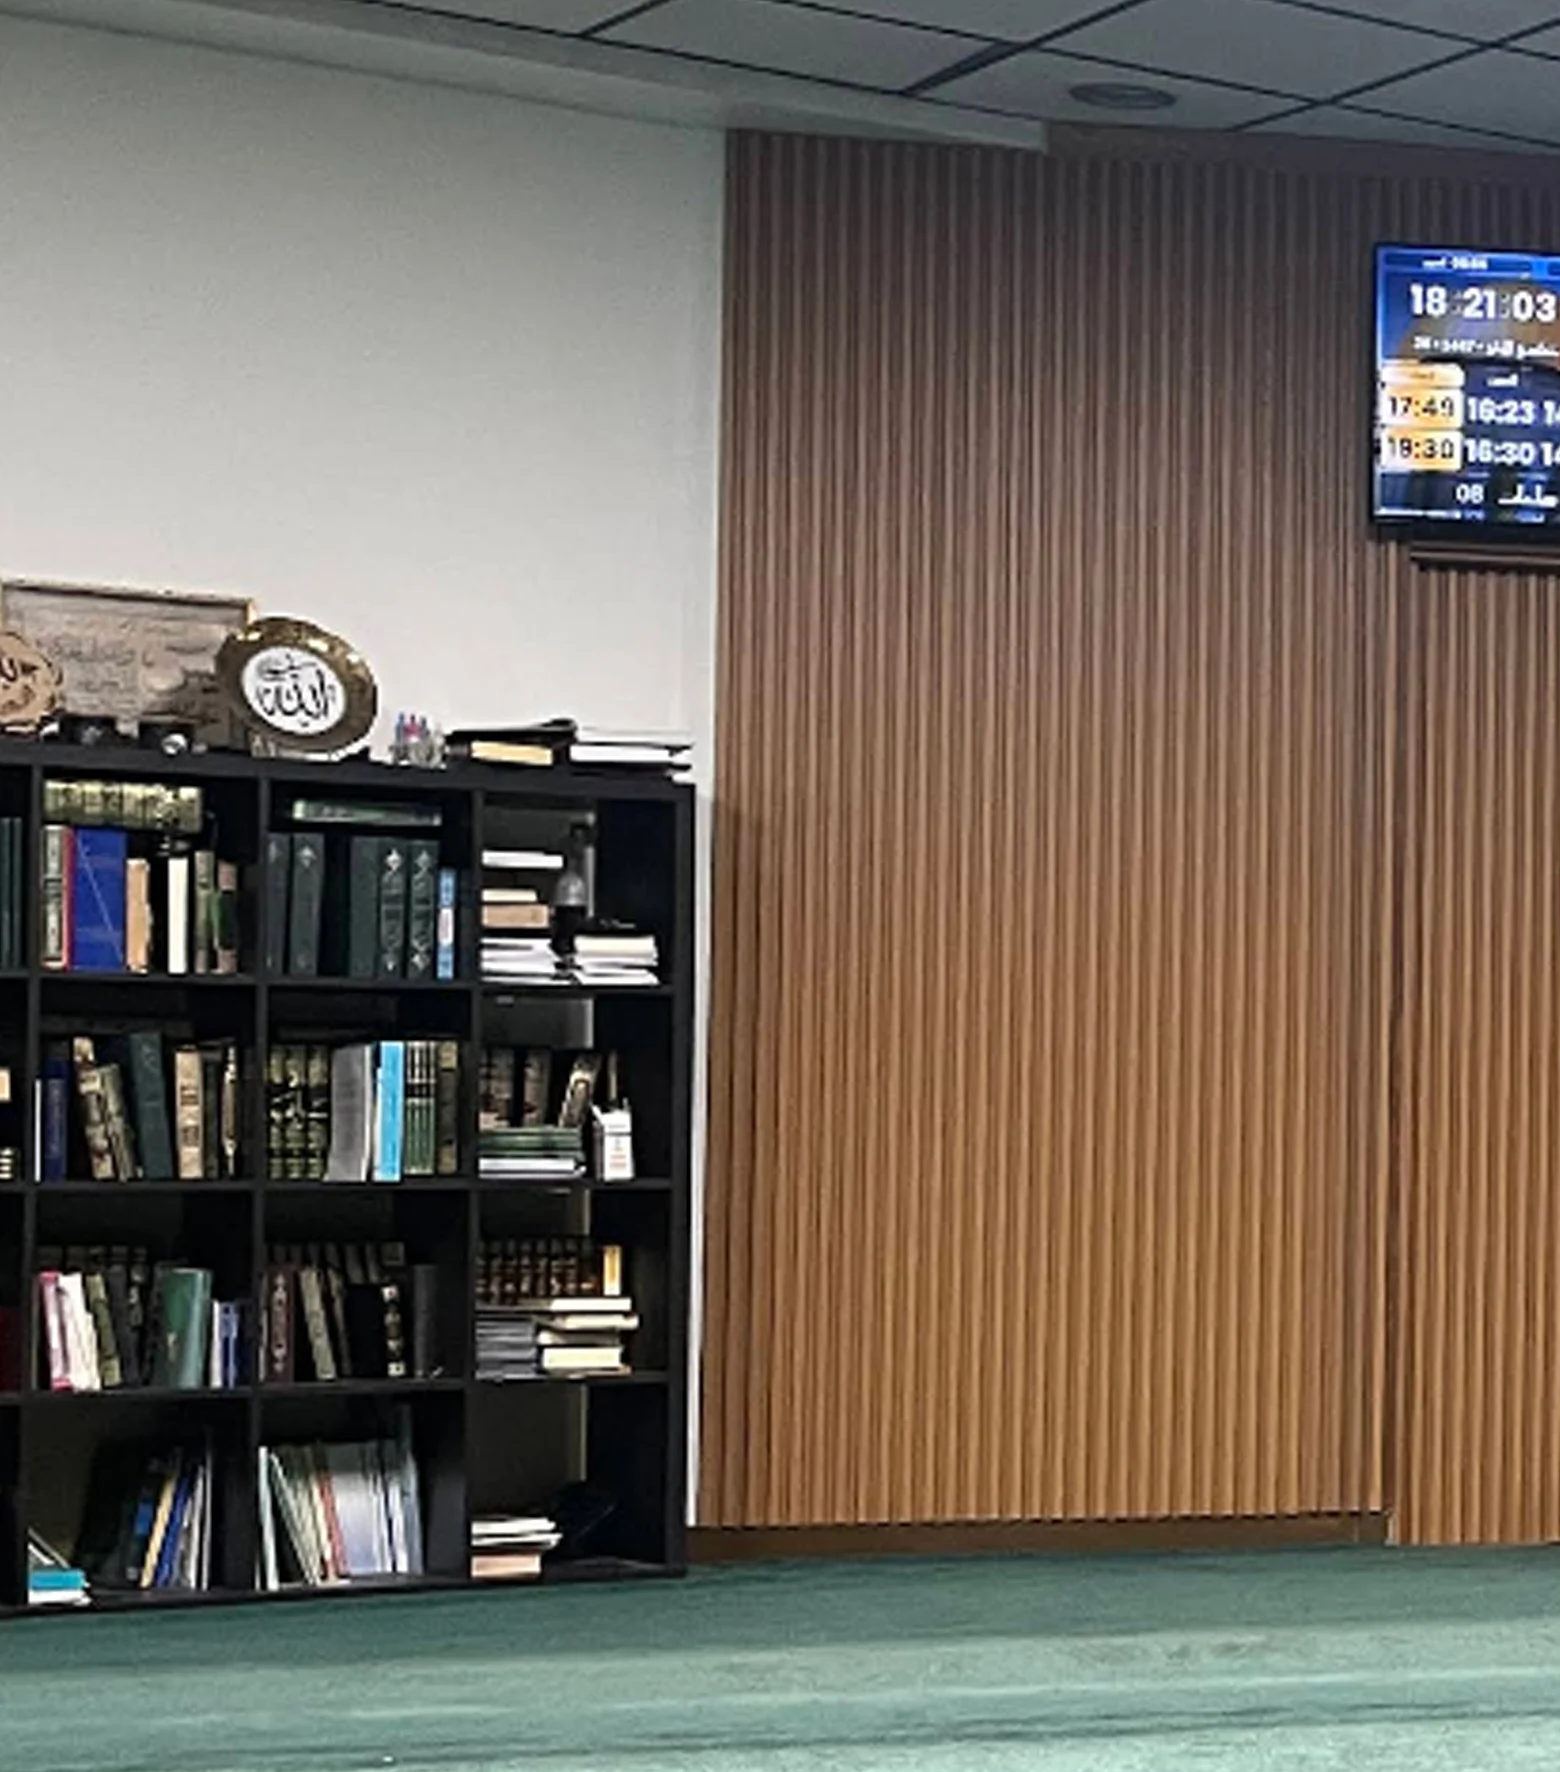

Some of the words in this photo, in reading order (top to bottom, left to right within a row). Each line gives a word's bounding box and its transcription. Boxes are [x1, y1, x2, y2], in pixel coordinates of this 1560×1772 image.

[1389, 396, 1455, 417] 17:49
[1468, 397, 1535, 424] 16:23
[1456, 483, 1484, 504] 08
